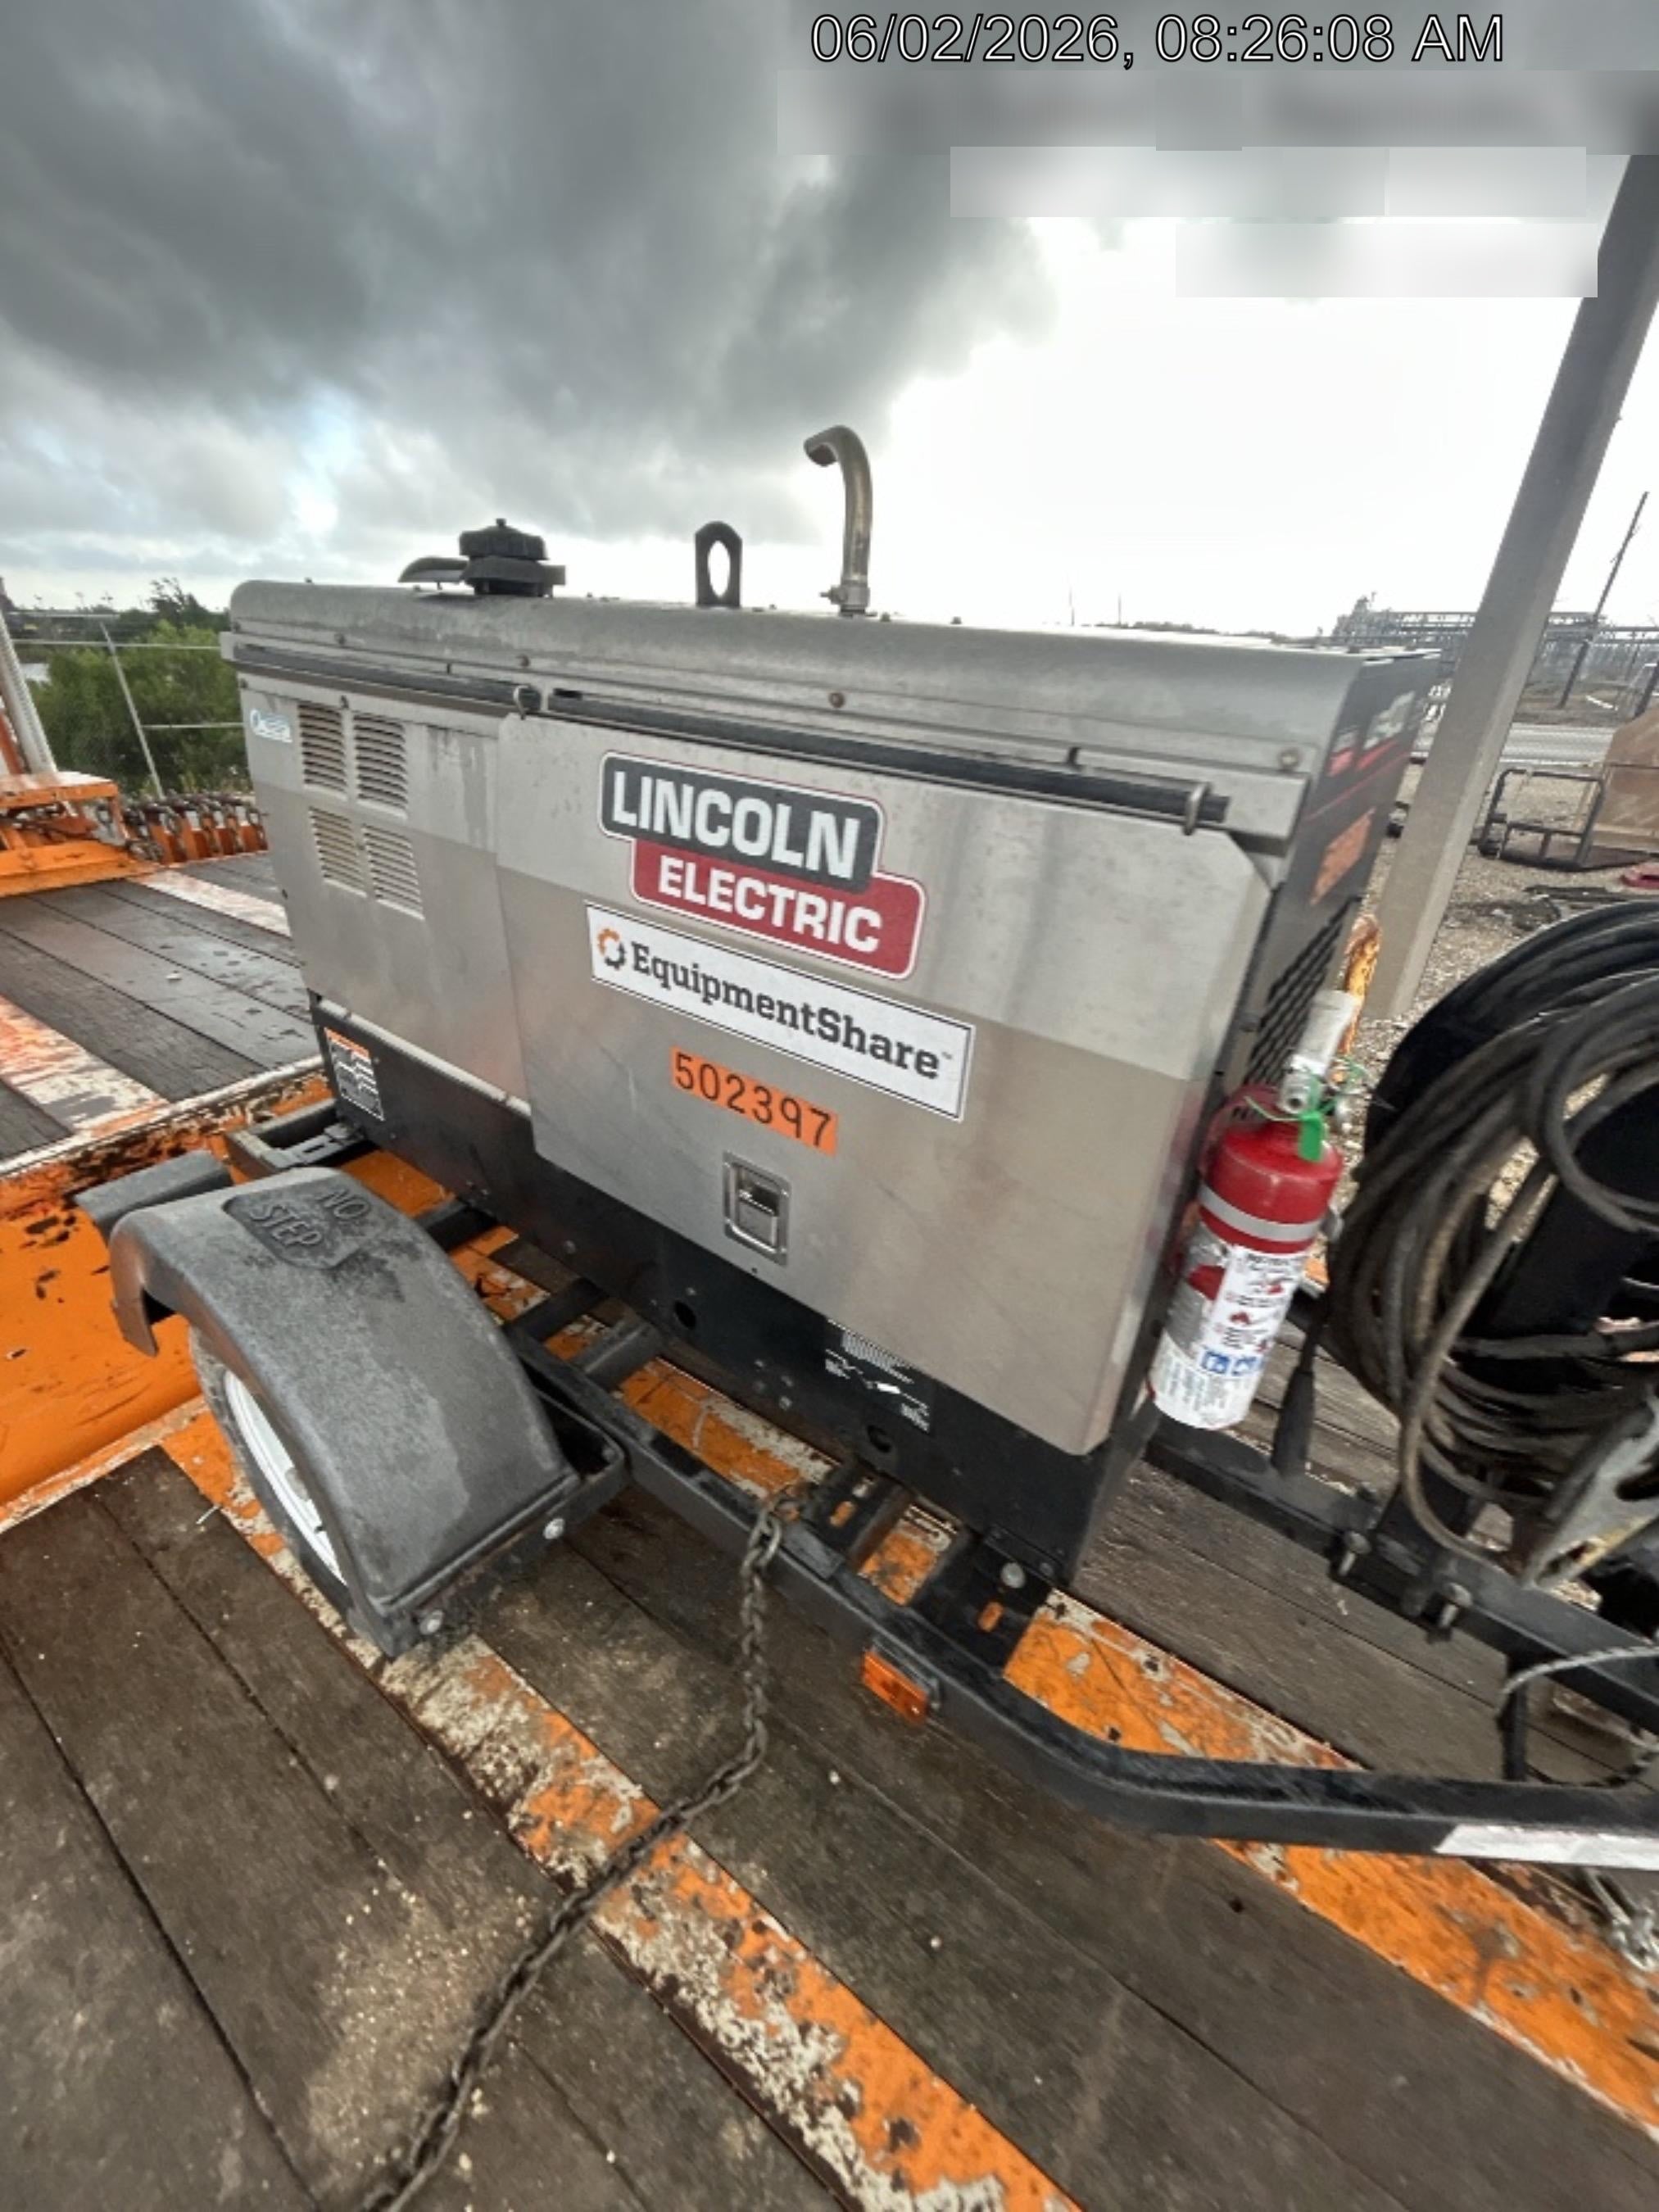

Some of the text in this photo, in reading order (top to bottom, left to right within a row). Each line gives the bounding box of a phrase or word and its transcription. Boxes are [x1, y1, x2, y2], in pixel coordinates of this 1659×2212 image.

[612, 770, 860, 880] LINCOLN
[658, 855, 883, 954] ELECTRIC
[631, 941, 940, 1081] EquipmentShare
[673, 1053, 834, 1148] 502397
[249, 1203, 324, 1247] STEP
[315, 1188, 371, 1221] NO
